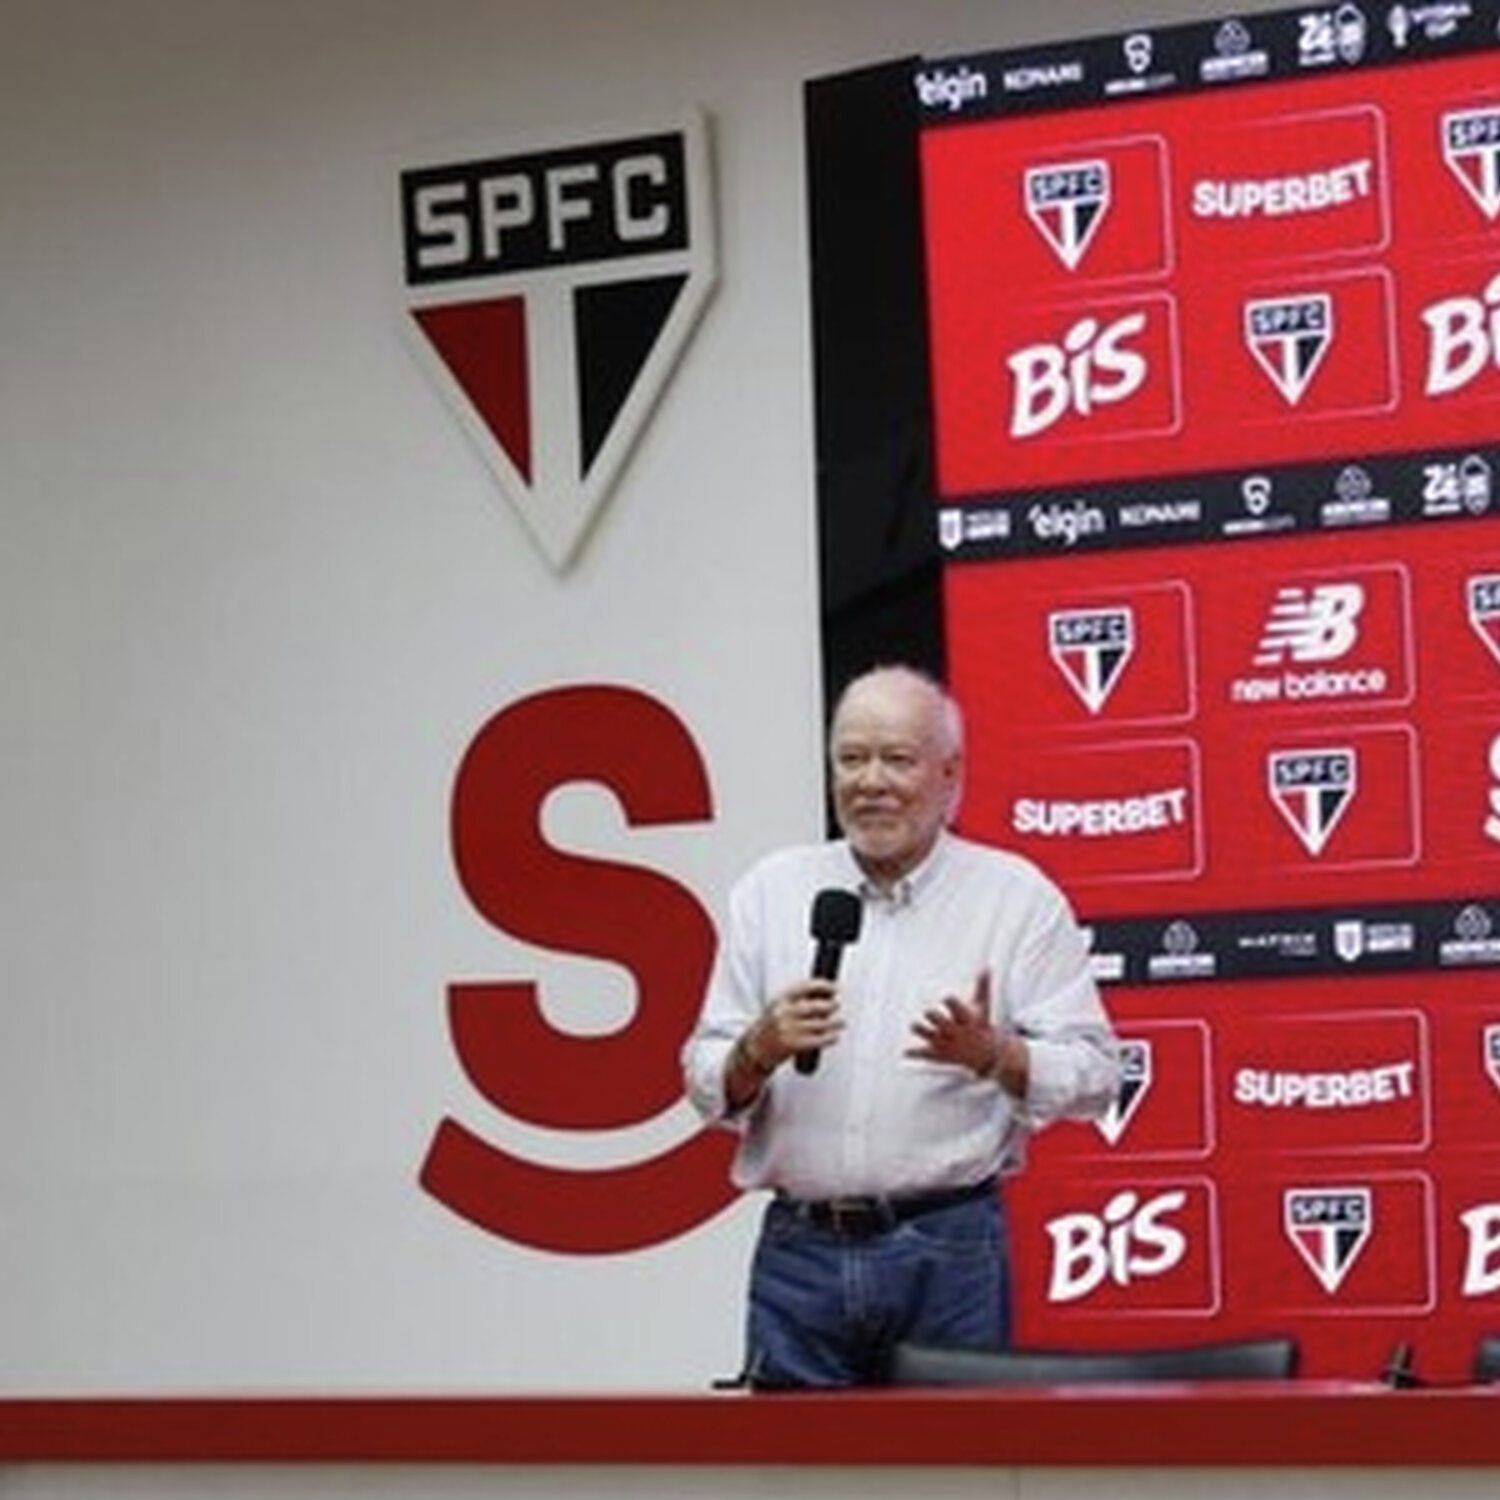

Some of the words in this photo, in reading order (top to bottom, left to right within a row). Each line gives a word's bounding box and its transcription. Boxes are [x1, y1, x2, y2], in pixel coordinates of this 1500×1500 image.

[1004, 63, 1083, 90] KONAMI
[1032, 172, 1101, 199] SPFC
[1192, 161, 1374, 219] SUPERBET
[414, 152, 671, 268] SPFC
[1252, 306, 1324, 333] SPFC
[1119, 500, 1200, 526] KONAMI
[1058, 618, 1125, 642] SPFC
[1232, 679, 1281, 702] new
[1288, 666, 1386, 698] balance
[1276, 758, 1349, 784] SPFC
[1012, 789, 1191, 838] SUPERBET
[1234, 1062, 1414, 1108] SUPERBET
[1292, 1197, 1364, 1222] SPFC
